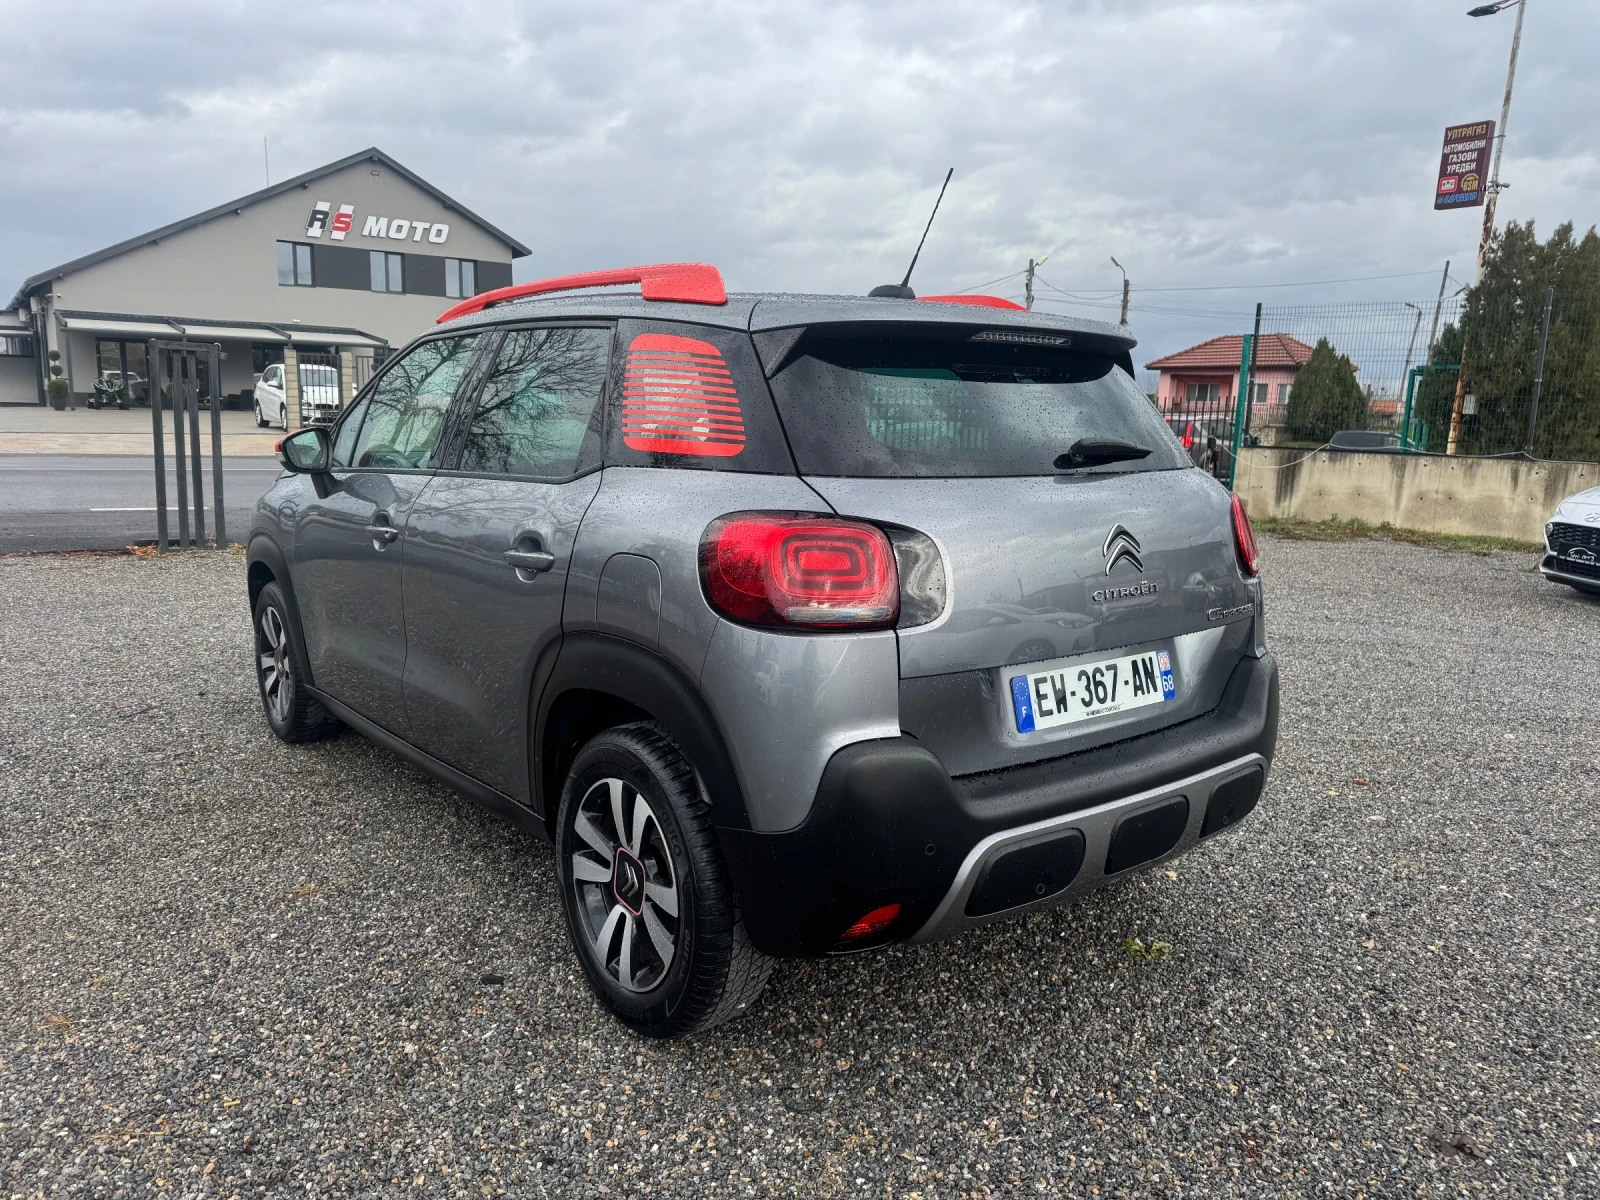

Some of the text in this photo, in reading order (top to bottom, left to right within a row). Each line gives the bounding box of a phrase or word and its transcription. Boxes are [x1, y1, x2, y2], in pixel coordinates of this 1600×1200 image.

[1443, 140, 1486, 153] АВТОМОБИЛНИ
[1449, 151, 1477, 163] ГАЗОВИ
[1447, 162, 1476, 173] УРЕДБИ
[306, 207, 449, 244] RS MOTO
[1033, 656, 1158, 718] EW-367-AN
[1162, 675, 1174, 691] 68
[1021, 706, 1027, 718] F
